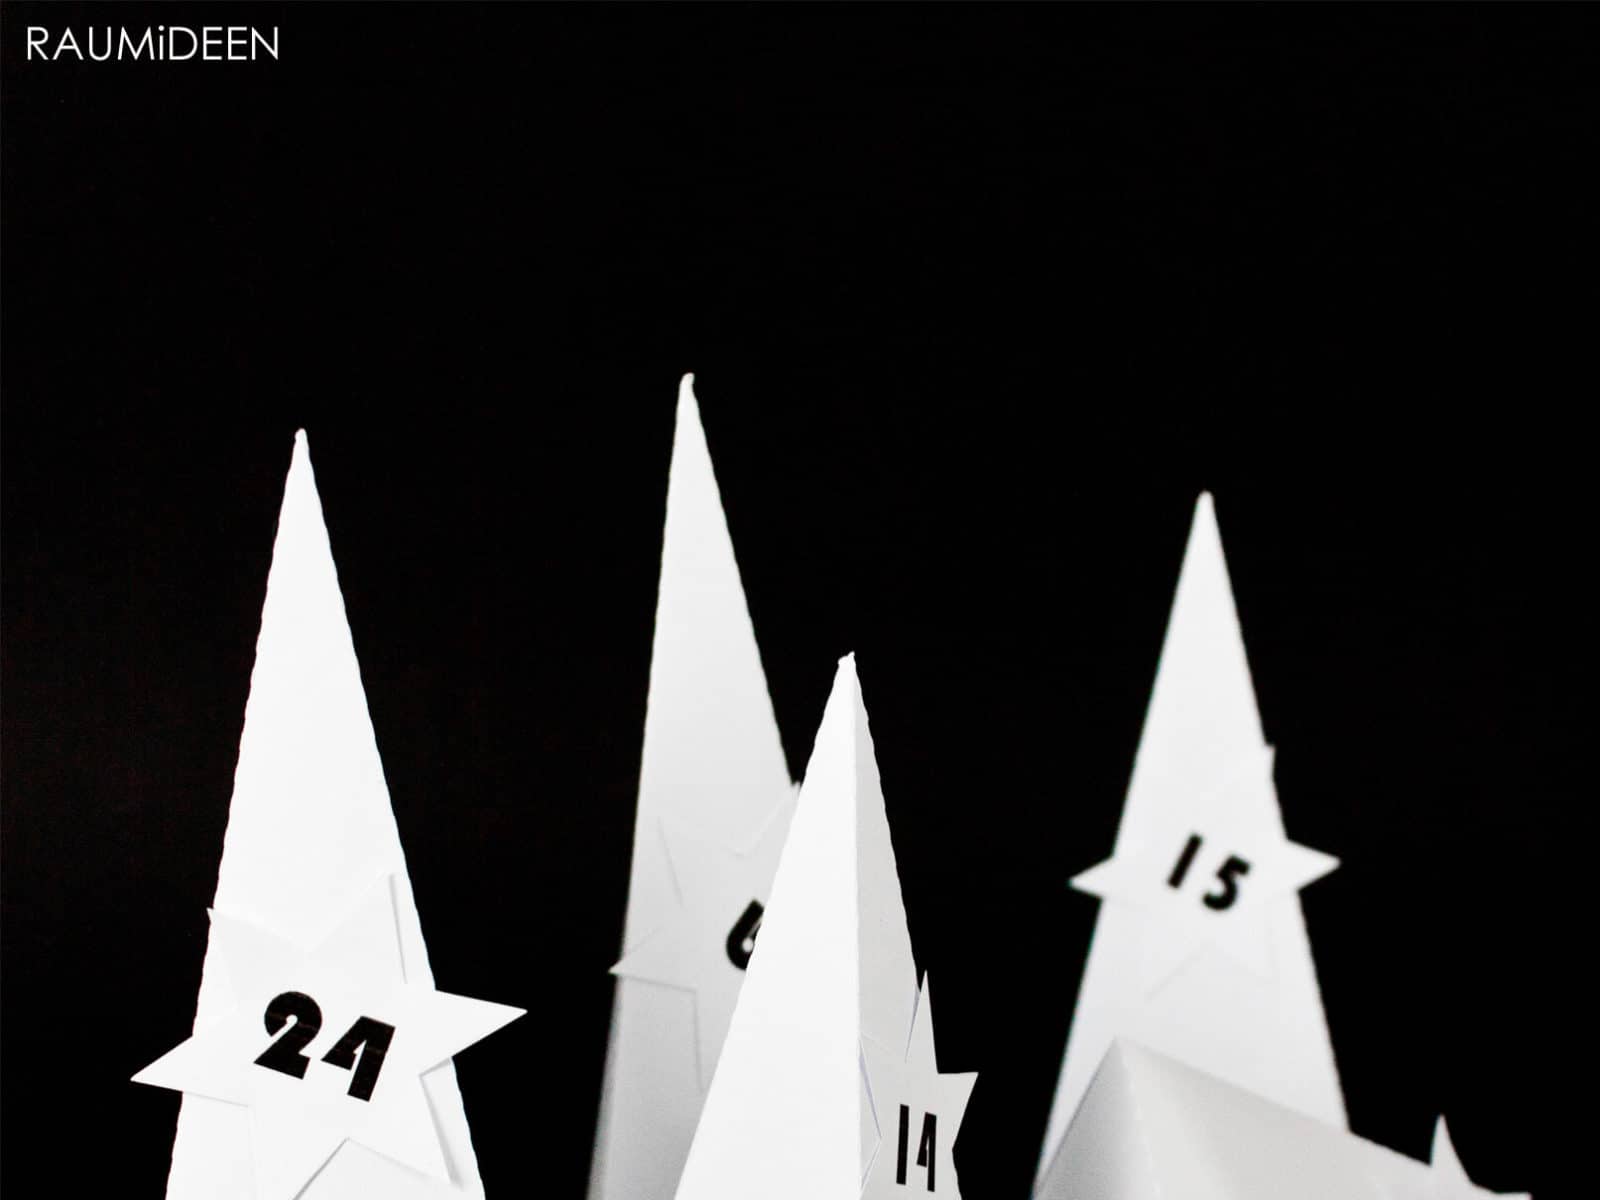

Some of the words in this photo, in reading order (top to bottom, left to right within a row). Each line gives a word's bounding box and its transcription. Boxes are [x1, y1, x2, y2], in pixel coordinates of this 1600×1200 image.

[1167, 833, 1251, 912] 15
[252, 990, 397, 1103] 24
[895, 1103, 938, 1193] 14
